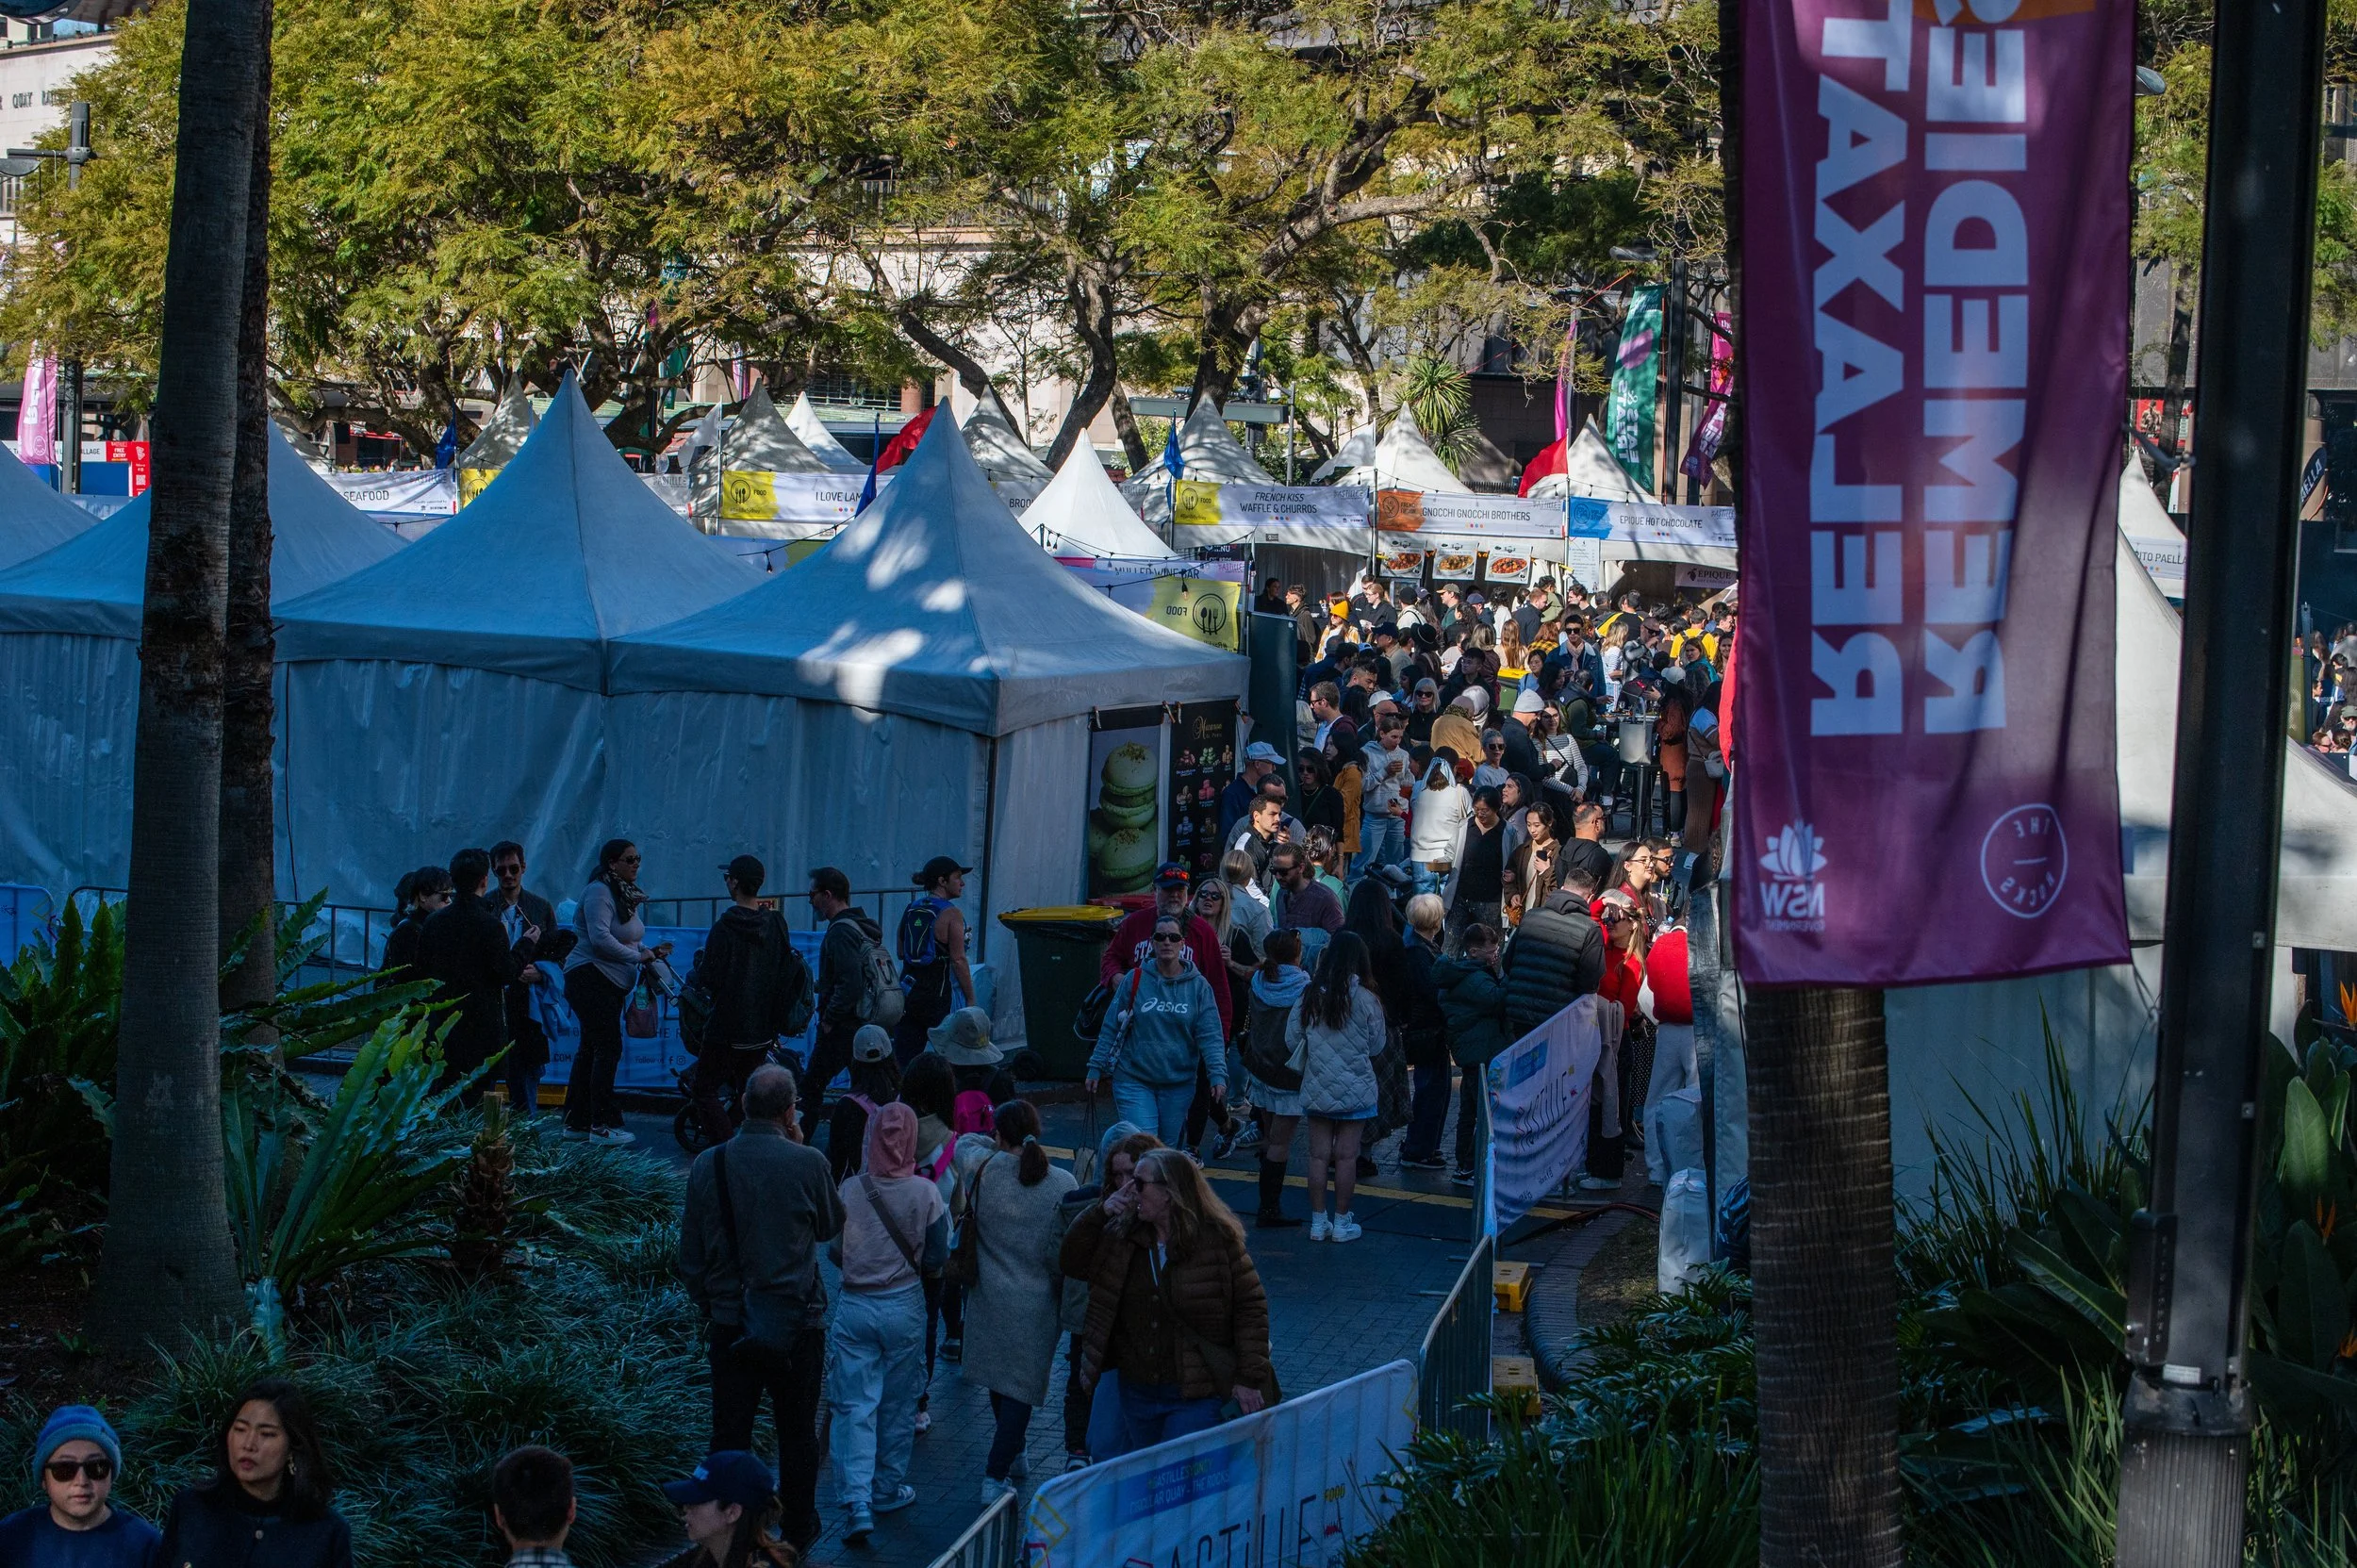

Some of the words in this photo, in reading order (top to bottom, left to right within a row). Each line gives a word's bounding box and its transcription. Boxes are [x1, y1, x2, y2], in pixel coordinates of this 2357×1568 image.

[344, 490, 389, 502] SEAFOOD
[820, 491, 843, 502] LOVE
[1255, 491, 1286, 502] FRENCH
[1287, 493, 1305, 502] KISS
[1240, 503, 1272, 513] WAFFLE
[1273, 503, 1279, 513] &
[1280, 504, 1318, 514] CHURROS
[1422, 506, 1456, 518] GNOCCHI
[1457, 507, 1490, 519] GNOCCHI
[1492, 510, 1531, 520] BROTHERS
[1620, 516, 1645, 526] EPIQUE
[1645, 518, 1659, 527] HOT
[1660, 518, 1703, 529] CHOCOLATE
[2154, 553, 2186, 565] PAELLA
[1156, 1000, 1189, 1014] asics
